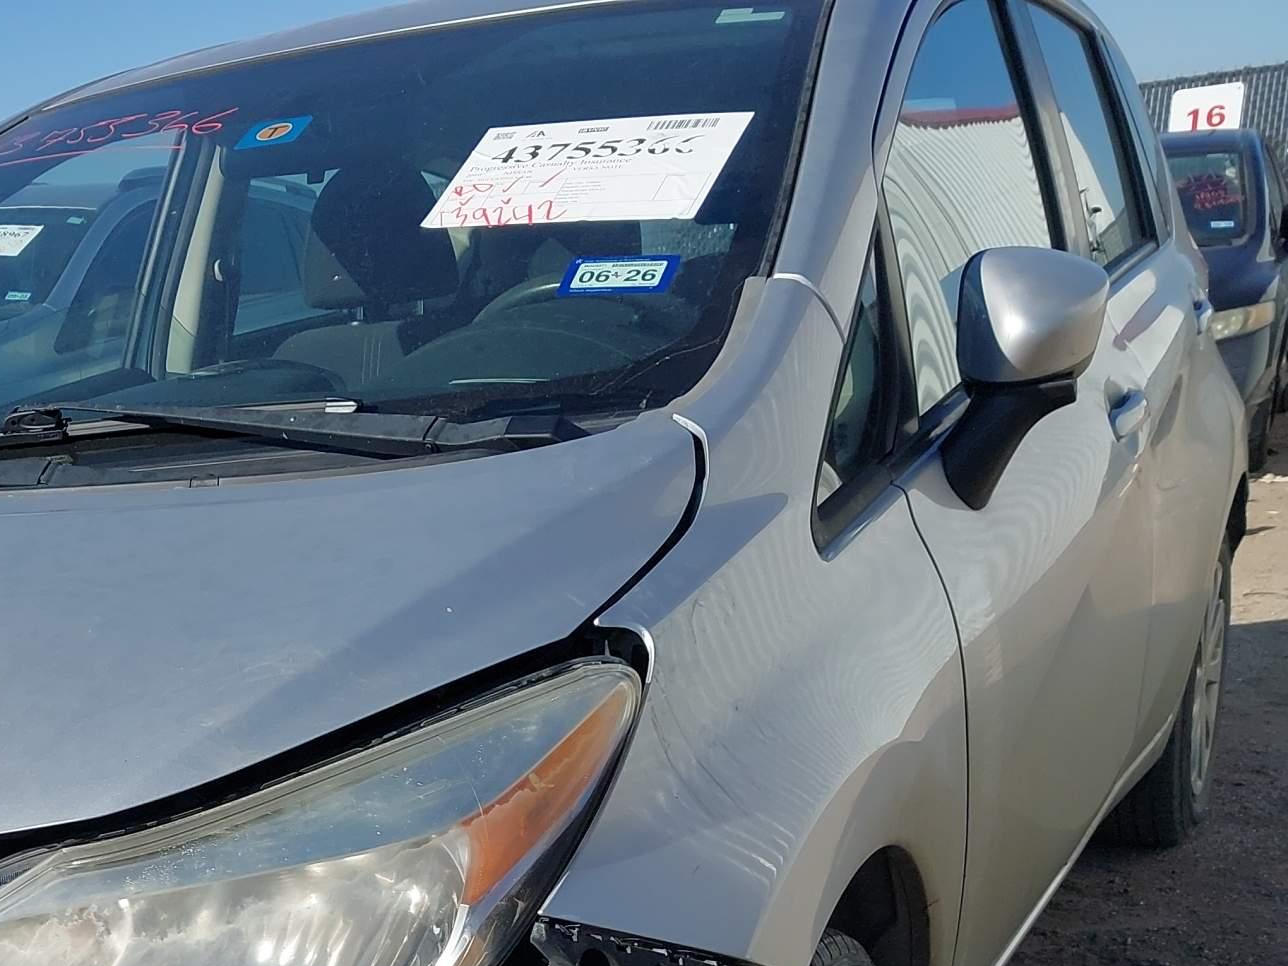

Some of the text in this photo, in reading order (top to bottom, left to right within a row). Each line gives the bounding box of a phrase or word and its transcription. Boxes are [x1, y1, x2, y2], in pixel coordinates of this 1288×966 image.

[1186, 104, 1226, 132] 16
[491, 134, 705, 163] 43755366
[578, 268, 657, 283] 06 26
